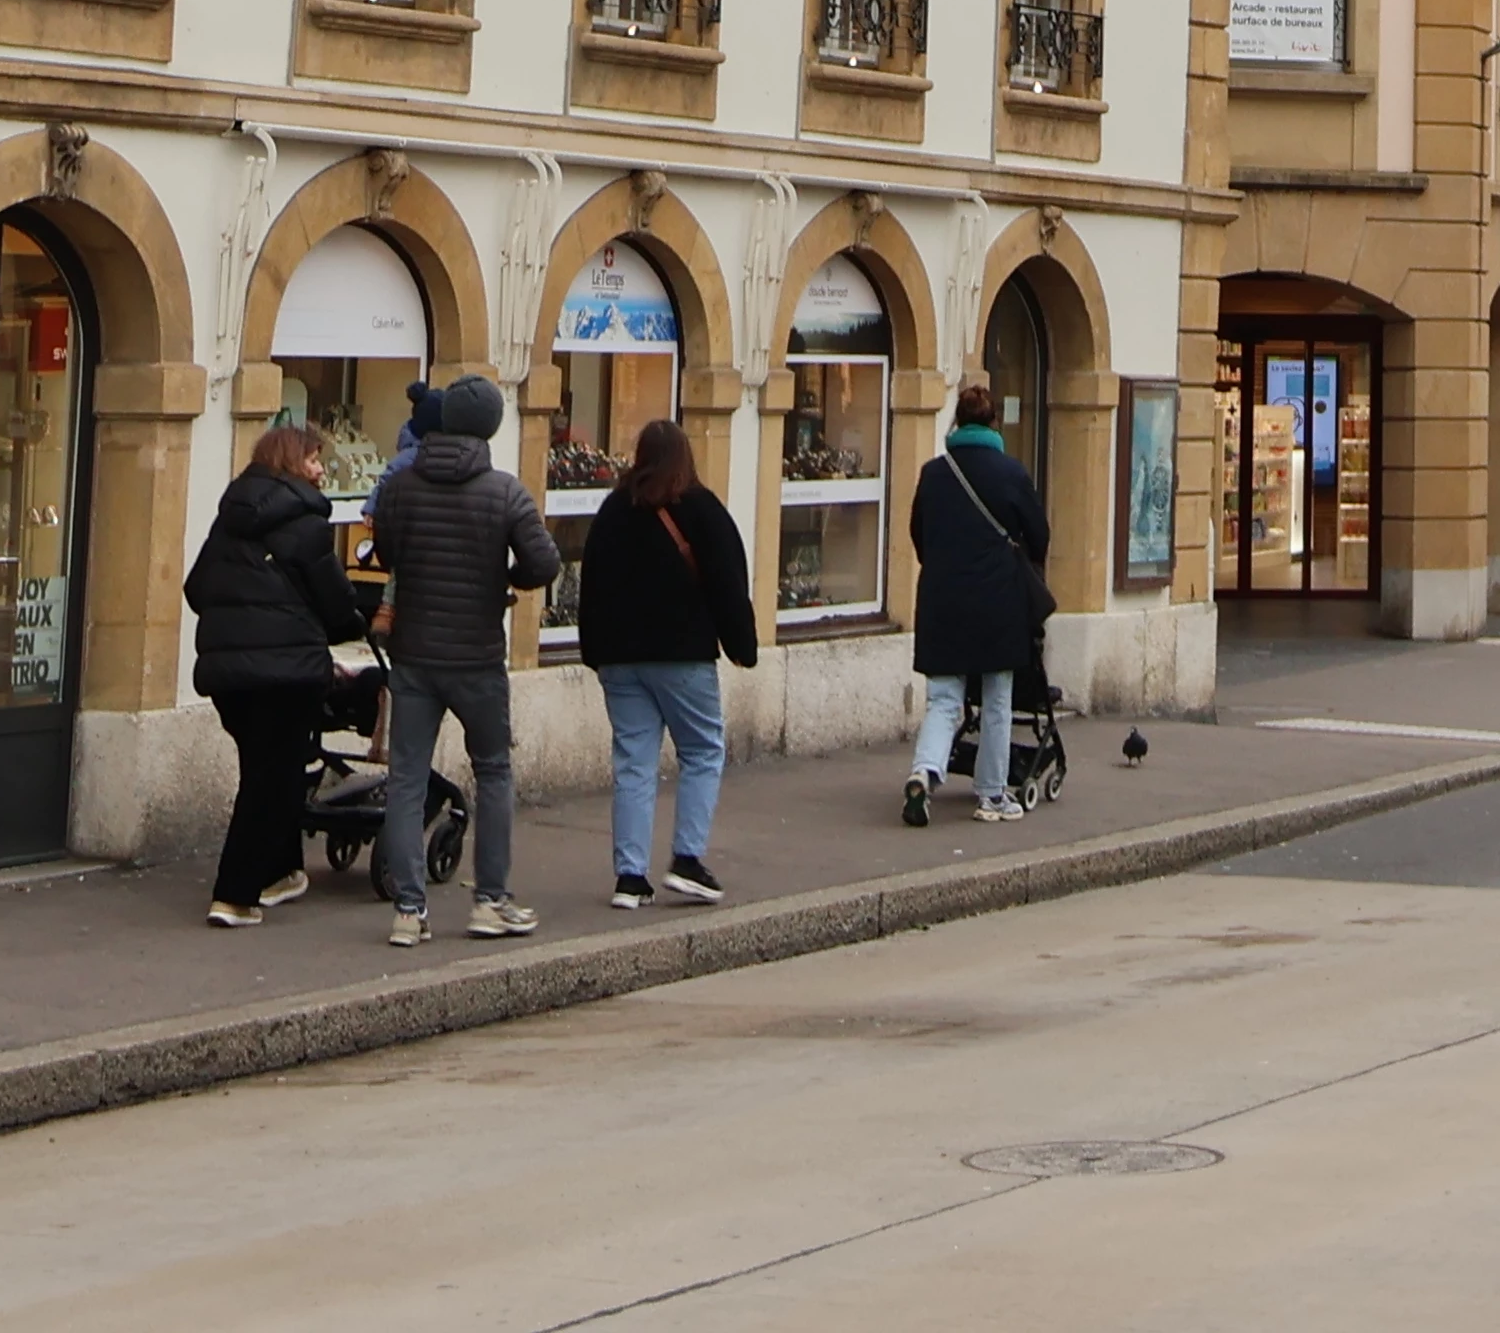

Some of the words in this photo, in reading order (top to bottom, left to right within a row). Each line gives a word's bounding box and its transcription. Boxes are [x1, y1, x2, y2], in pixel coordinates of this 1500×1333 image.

[1232, 2, 1266, 12] Arcade
[1275, 5, 1323, 14] restaurant
[1232, 16, 1268, 26] surface
[1270, 17, 1282, 27] de
[1285, 18, 1323, 28] bureaux
